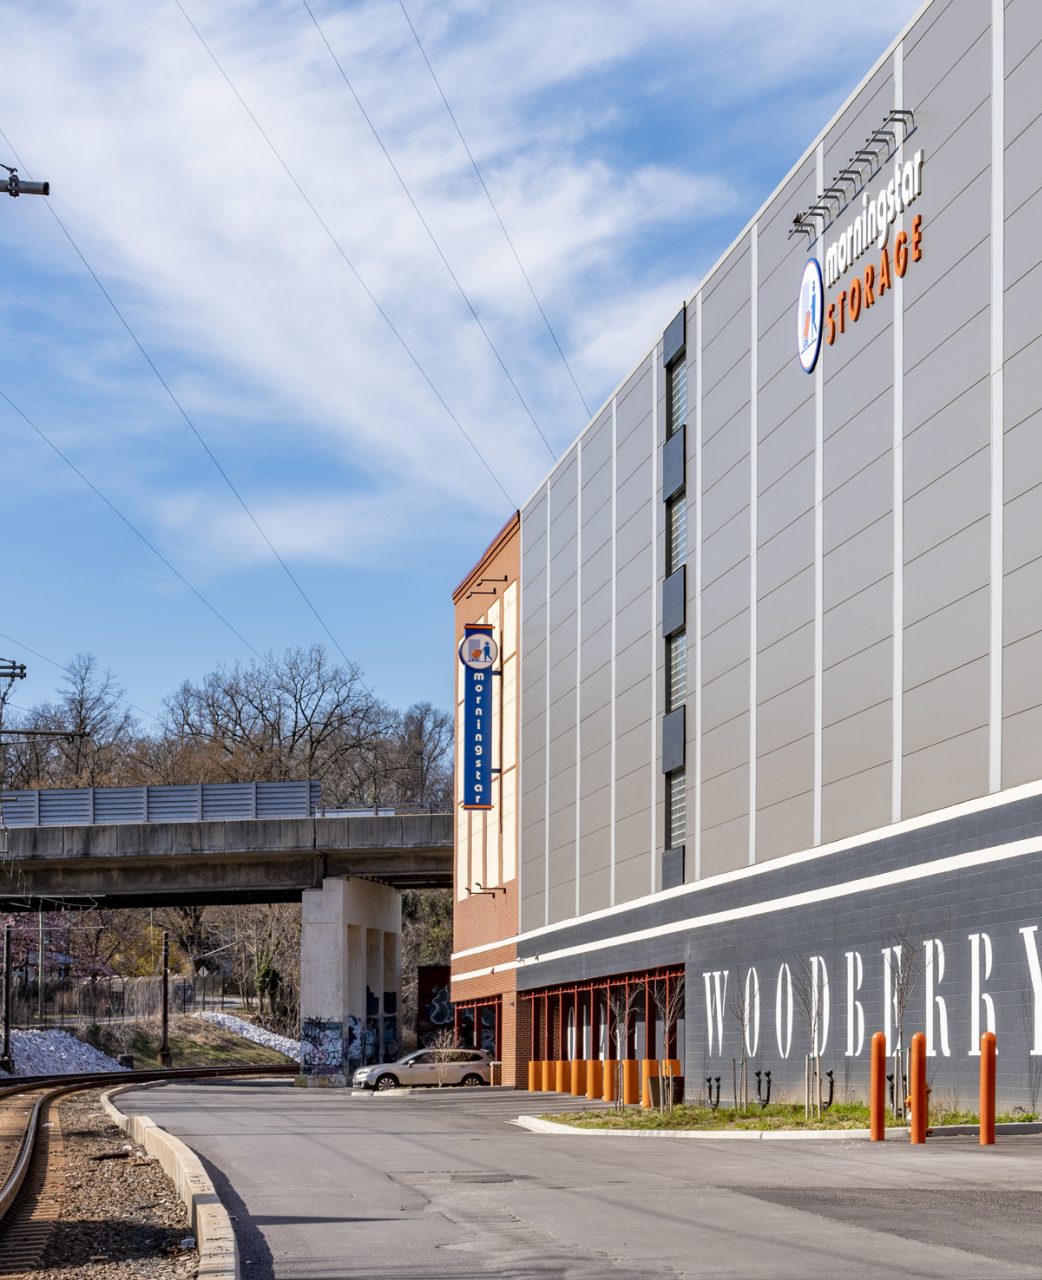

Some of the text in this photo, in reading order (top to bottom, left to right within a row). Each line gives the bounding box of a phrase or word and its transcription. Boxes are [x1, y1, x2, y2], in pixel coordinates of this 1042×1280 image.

[825, 151, 924, 288] morningstar
[825, 214, 923, 346] STORAGE
[474, 672, 484, 803] morningstar
